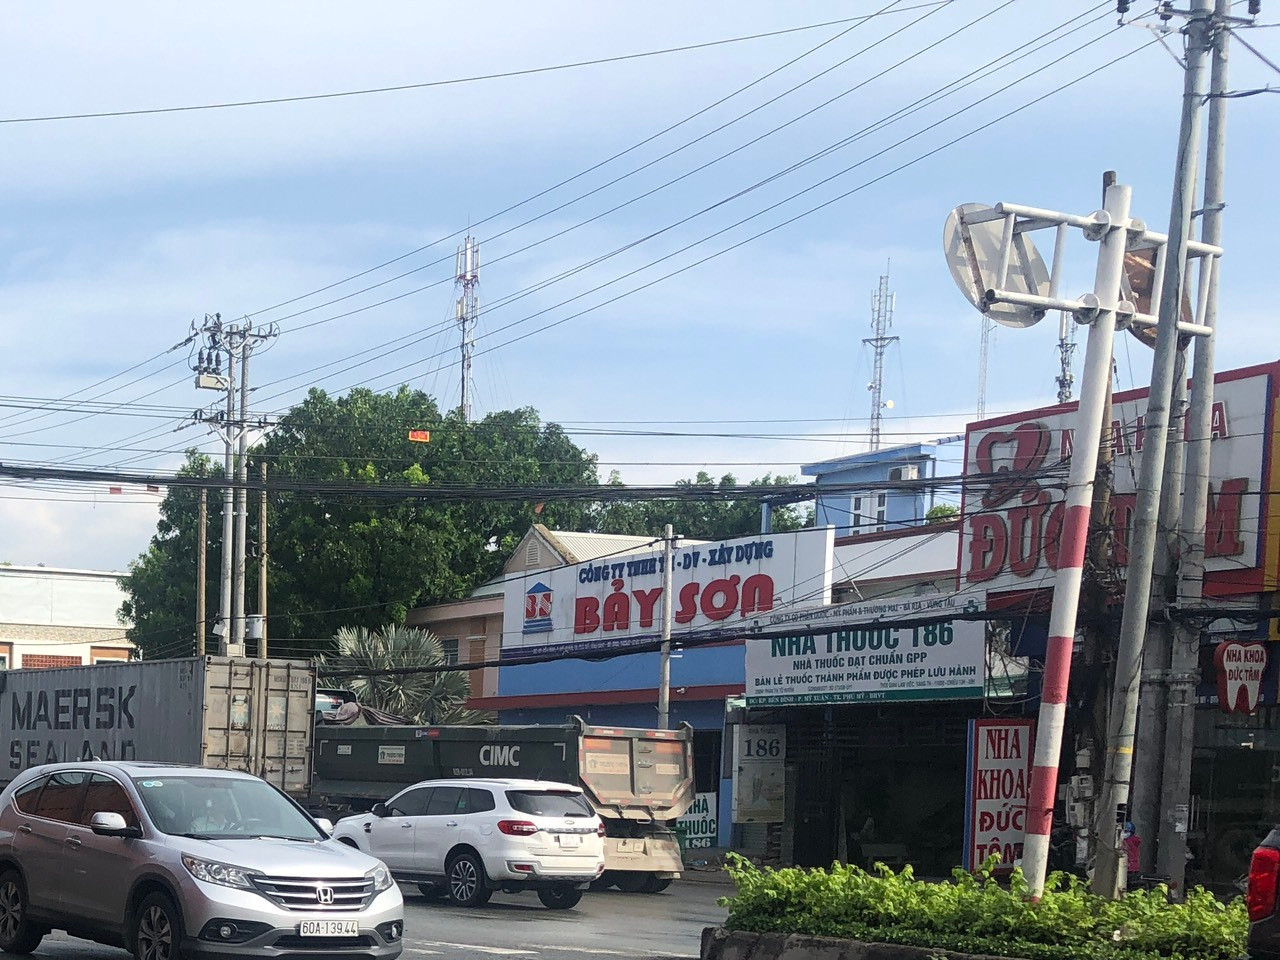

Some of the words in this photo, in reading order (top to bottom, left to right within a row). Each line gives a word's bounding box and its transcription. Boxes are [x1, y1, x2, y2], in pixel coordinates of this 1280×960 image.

[579, 563, 610, 584] CÔNG
[611, 562, 625, 579] TY
[626, 558, 657, 577] TNHH
[683, 551, 700, 569] DV
[708, 543, 734, 566] XÂY
[735, 541, 773, 565] DỰNG
[574, 578, 664, 634] BẢY
[912, 619, 954, 648] 186
[793, 658, 812, 670] NHÀ
[815, 654, 844, 669] THUỐC
[847, 656, 866, 669] ĐẠT
[869, 650, 902, 666] CHUẨN
[906, 652, 927, 664] GPP
[1226, 649, 1241, 662] NHA
[1243, 649, 1264, 663] KHOA
[785, 672, 813, 684] THUỐC
[846, 668, 871, 681] PHẨM
[873, 669, 898, 682] ĐƯỢC
[900, 666, 925, 679] PHÉP
[927, 665, 946, 678] LƯU
[949, 664, 976, 676] HÀNH
[1228, 666, 1243, 681] ĐỨC
[1244, 666, 1260, 681] TÂM
[11, 684, 137, 731] MAERSK
[479, 745, 520, 766] CIMC
[743, 738, 781, 757] 186
[985, 728, 1021, 759] NHA
[976, 768, 1026, 800] KHOA
[979, 802, 1023, 832] ĐỨC
[302, 922, 356, 934] 60A-139.44
